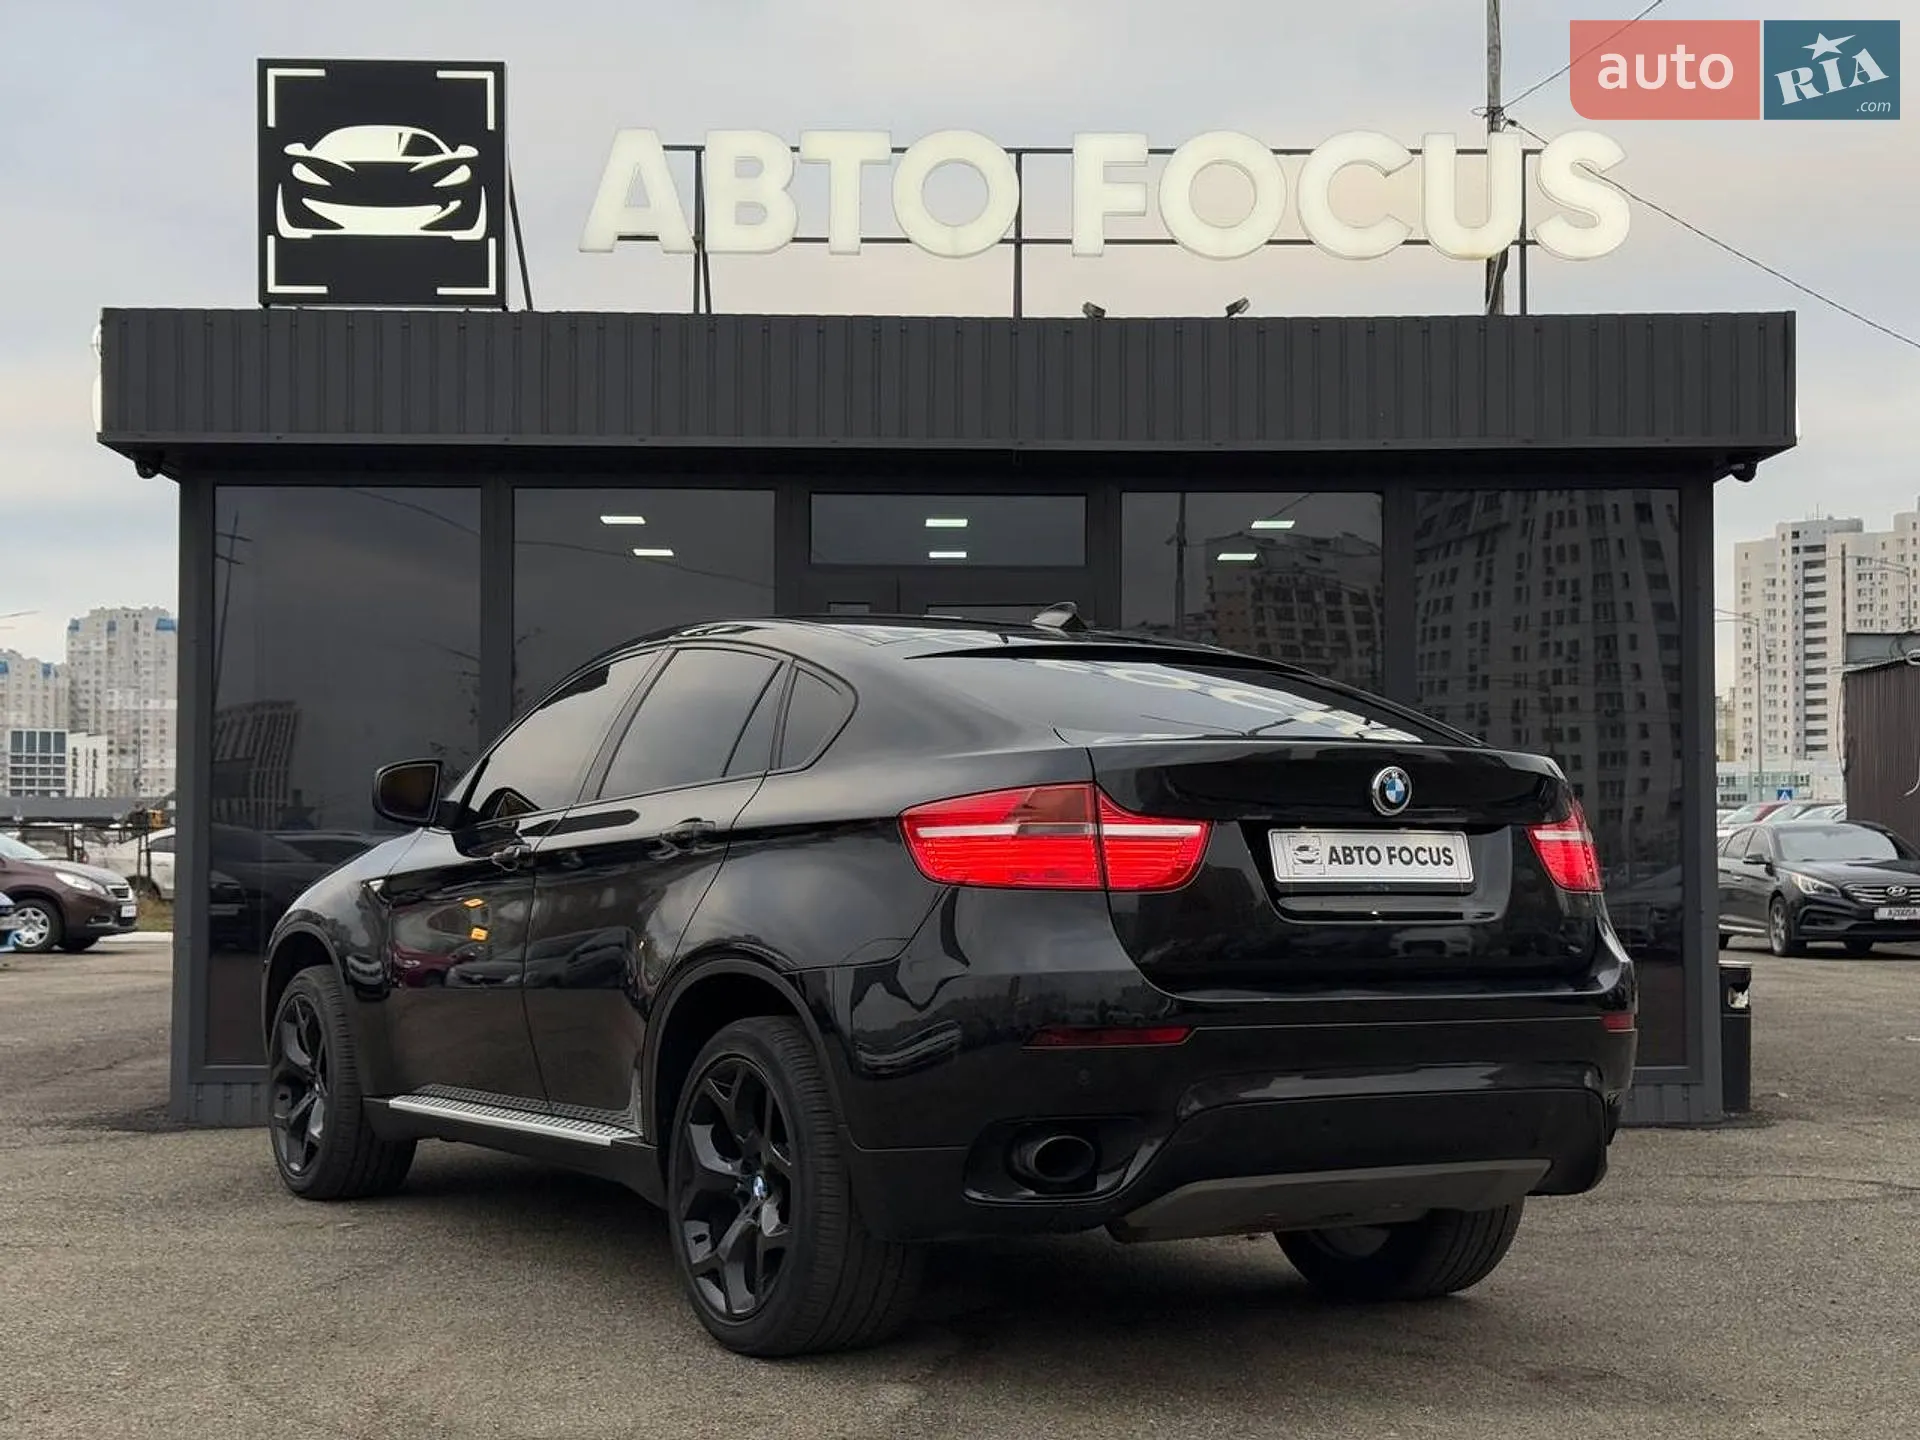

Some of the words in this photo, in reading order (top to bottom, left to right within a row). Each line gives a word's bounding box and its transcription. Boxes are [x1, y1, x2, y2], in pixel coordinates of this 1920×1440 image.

[578, 127, 1020, 259] АВТО
[1071, 130, 1631, 261] FOCUS
[1328, 845, 1382, 866] АВТО
[1386, 846, 1454, 867] FOCUS
